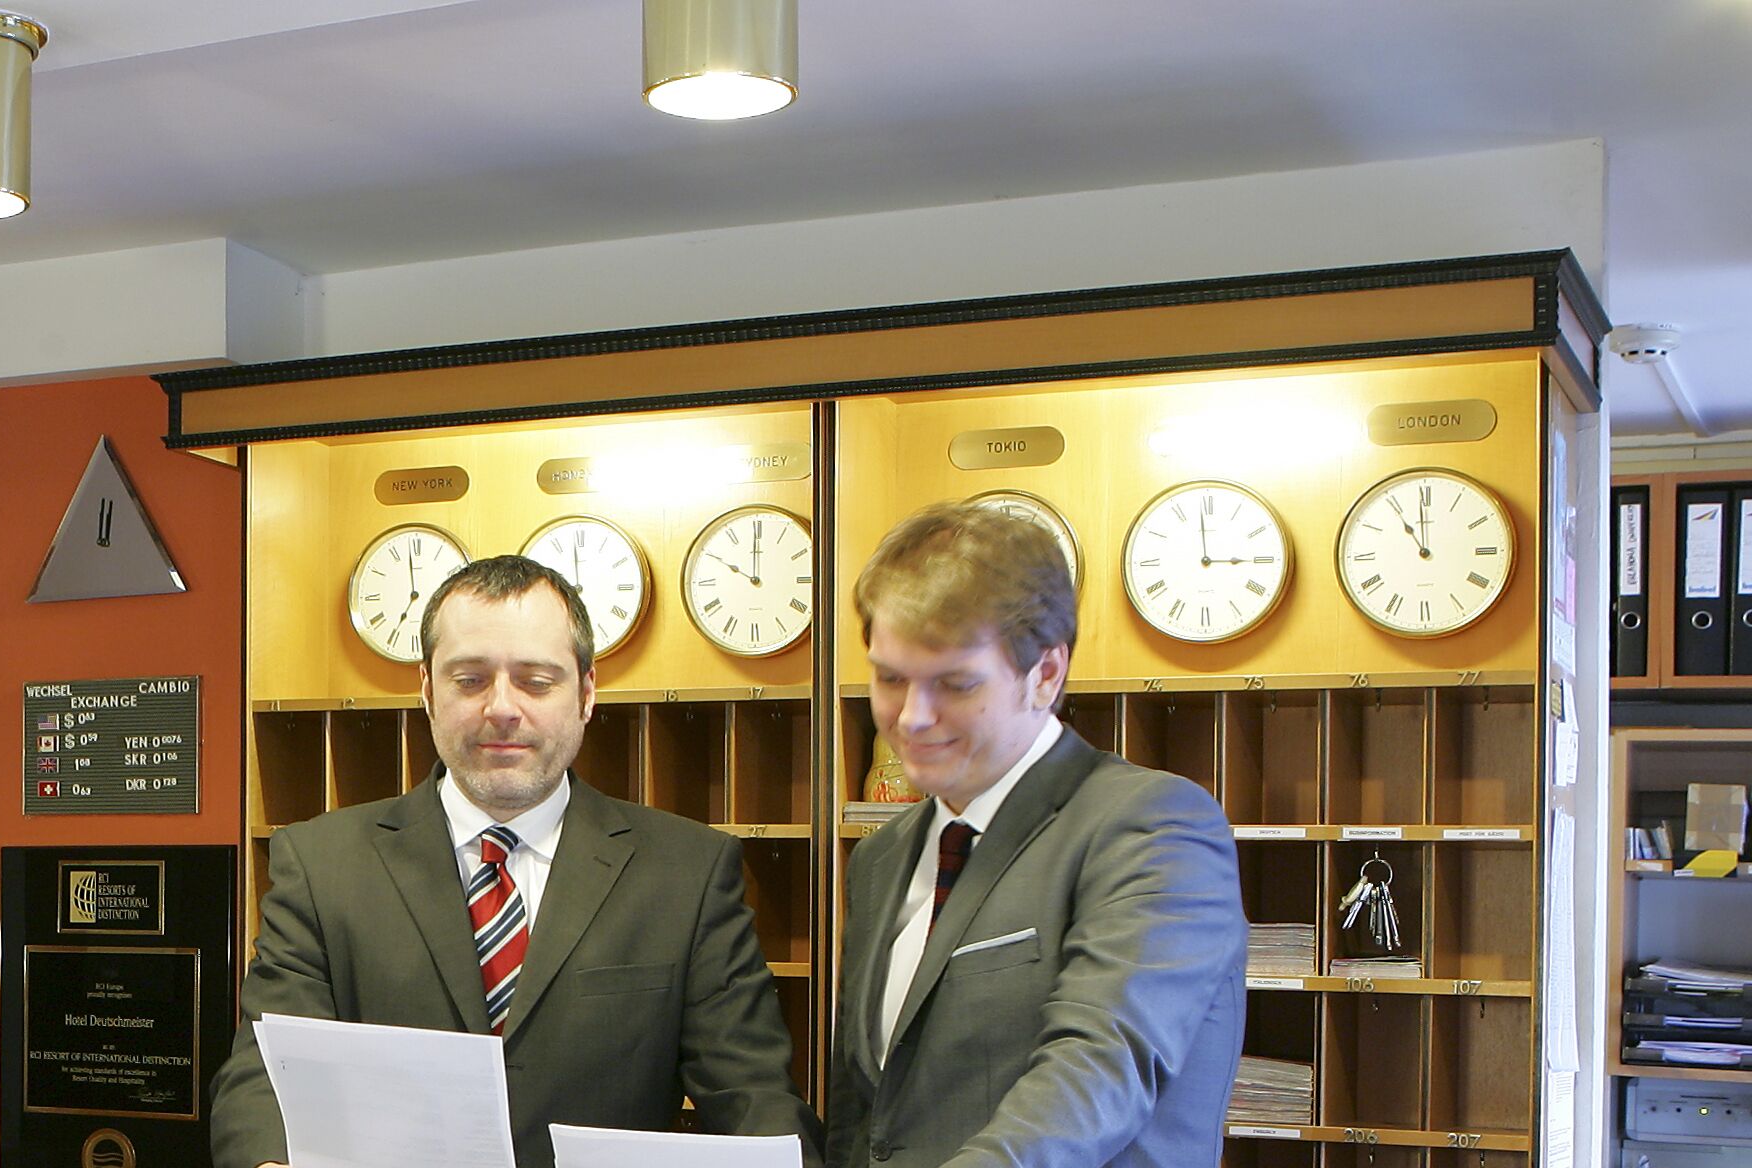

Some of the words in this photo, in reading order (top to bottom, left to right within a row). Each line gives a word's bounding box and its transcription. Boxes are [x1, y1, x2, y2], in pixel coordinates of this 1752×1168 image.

[1398, 414, 1461, 429] LONDON
[987, 441, 1026, 453] TOKIO
[740, 456, 787, 467] YDNEY
[392, 480, 417, 491] NEW
[423, 478, 453, 489] YORK
[1244, 677, 1264, 690] 75
[1350, 674, 1368, 687] 76
[1458, 671, 1483, 685] 77
[26, 685, 72, 698] WECHSEL
[138, 681, 190, 694] CAMBIO
[71, 695, 137, 708] EXCHANGE
[64, 713, 74, 729] $
[64, 733, 75, 749] $
[125, 736, 147, 749] YEN
[125, 753, 147, 766] SKR
[125, 778, 146, 791] DKR
[749, 826, 767, 838] 27
[1345, 977, 1375, 992] 106
[1452, 980, 1482, 995] 107
[65, 1013, 88, 1027] Hotel
[89, 1013, 155, 1028] Deutschmeister
[82, 1053, 141, 1064] INTERNATIONAL
[142, 1055, 191, 1066] DISTINCTION
[1344, 1128, 1378, 1144] 206
[1448, 1133, 1481, 1148] 207
